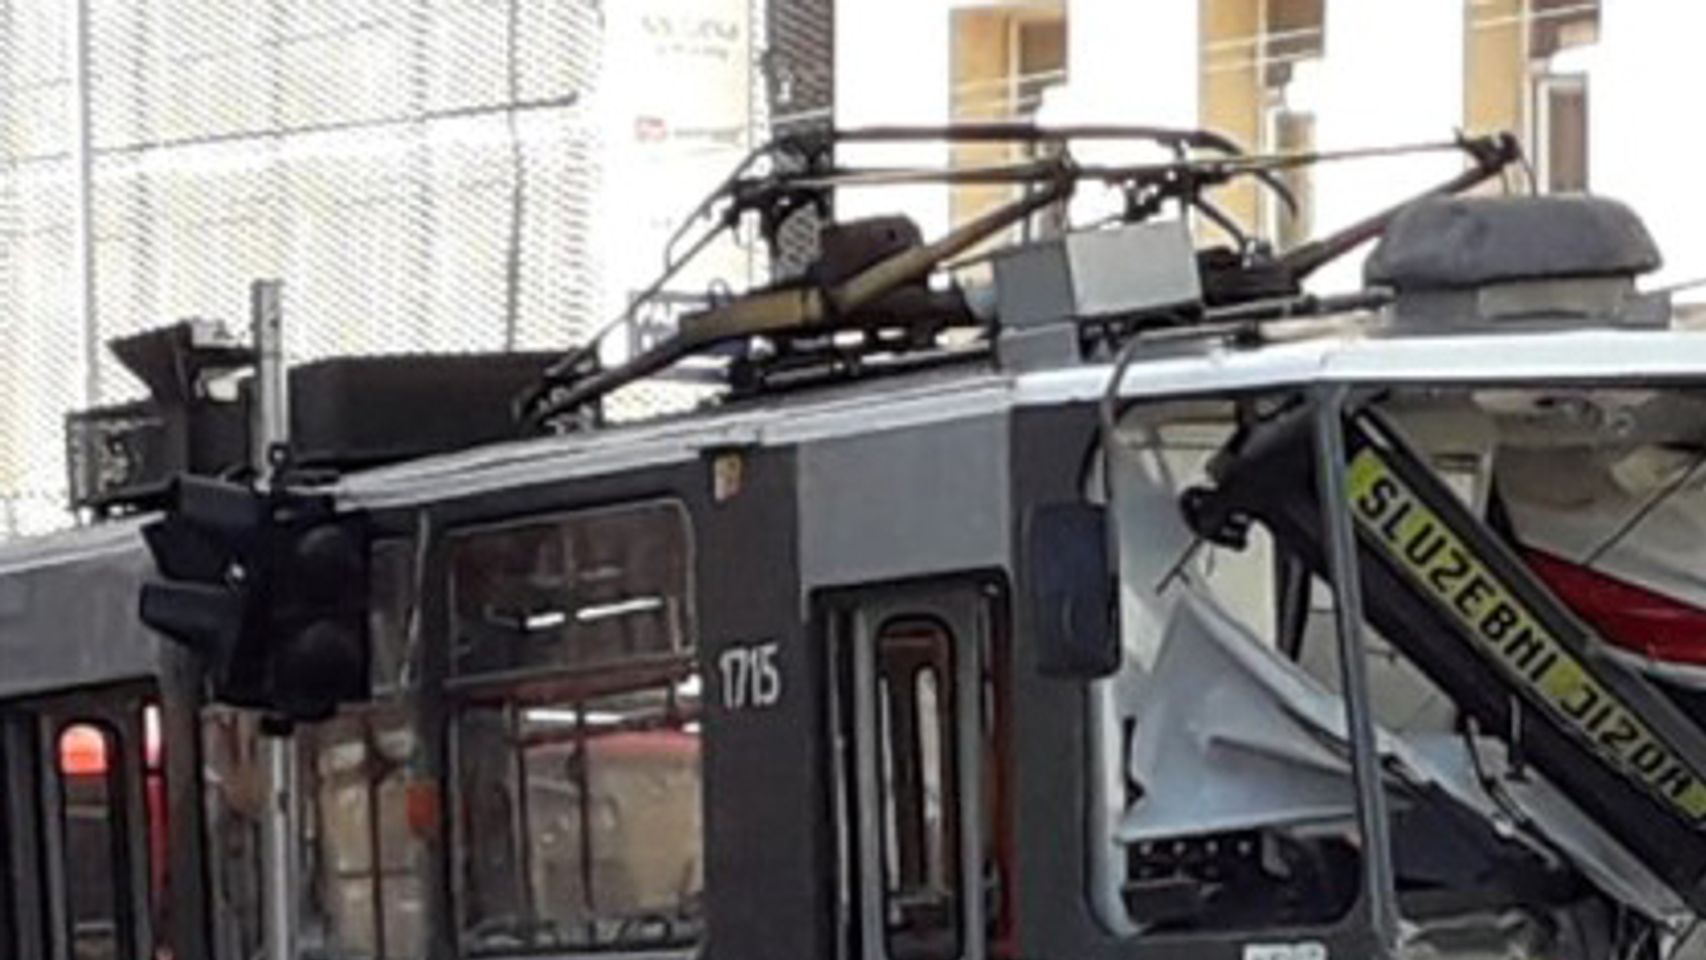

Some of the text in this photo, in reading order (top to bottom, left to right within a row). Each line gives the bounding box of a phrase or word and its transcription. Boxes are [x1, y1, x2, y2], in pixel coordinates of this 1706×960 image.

[720, 643, 780, 708] 1715
[1357, 478, 1694, 798] SLUZEBNI JIZDA
